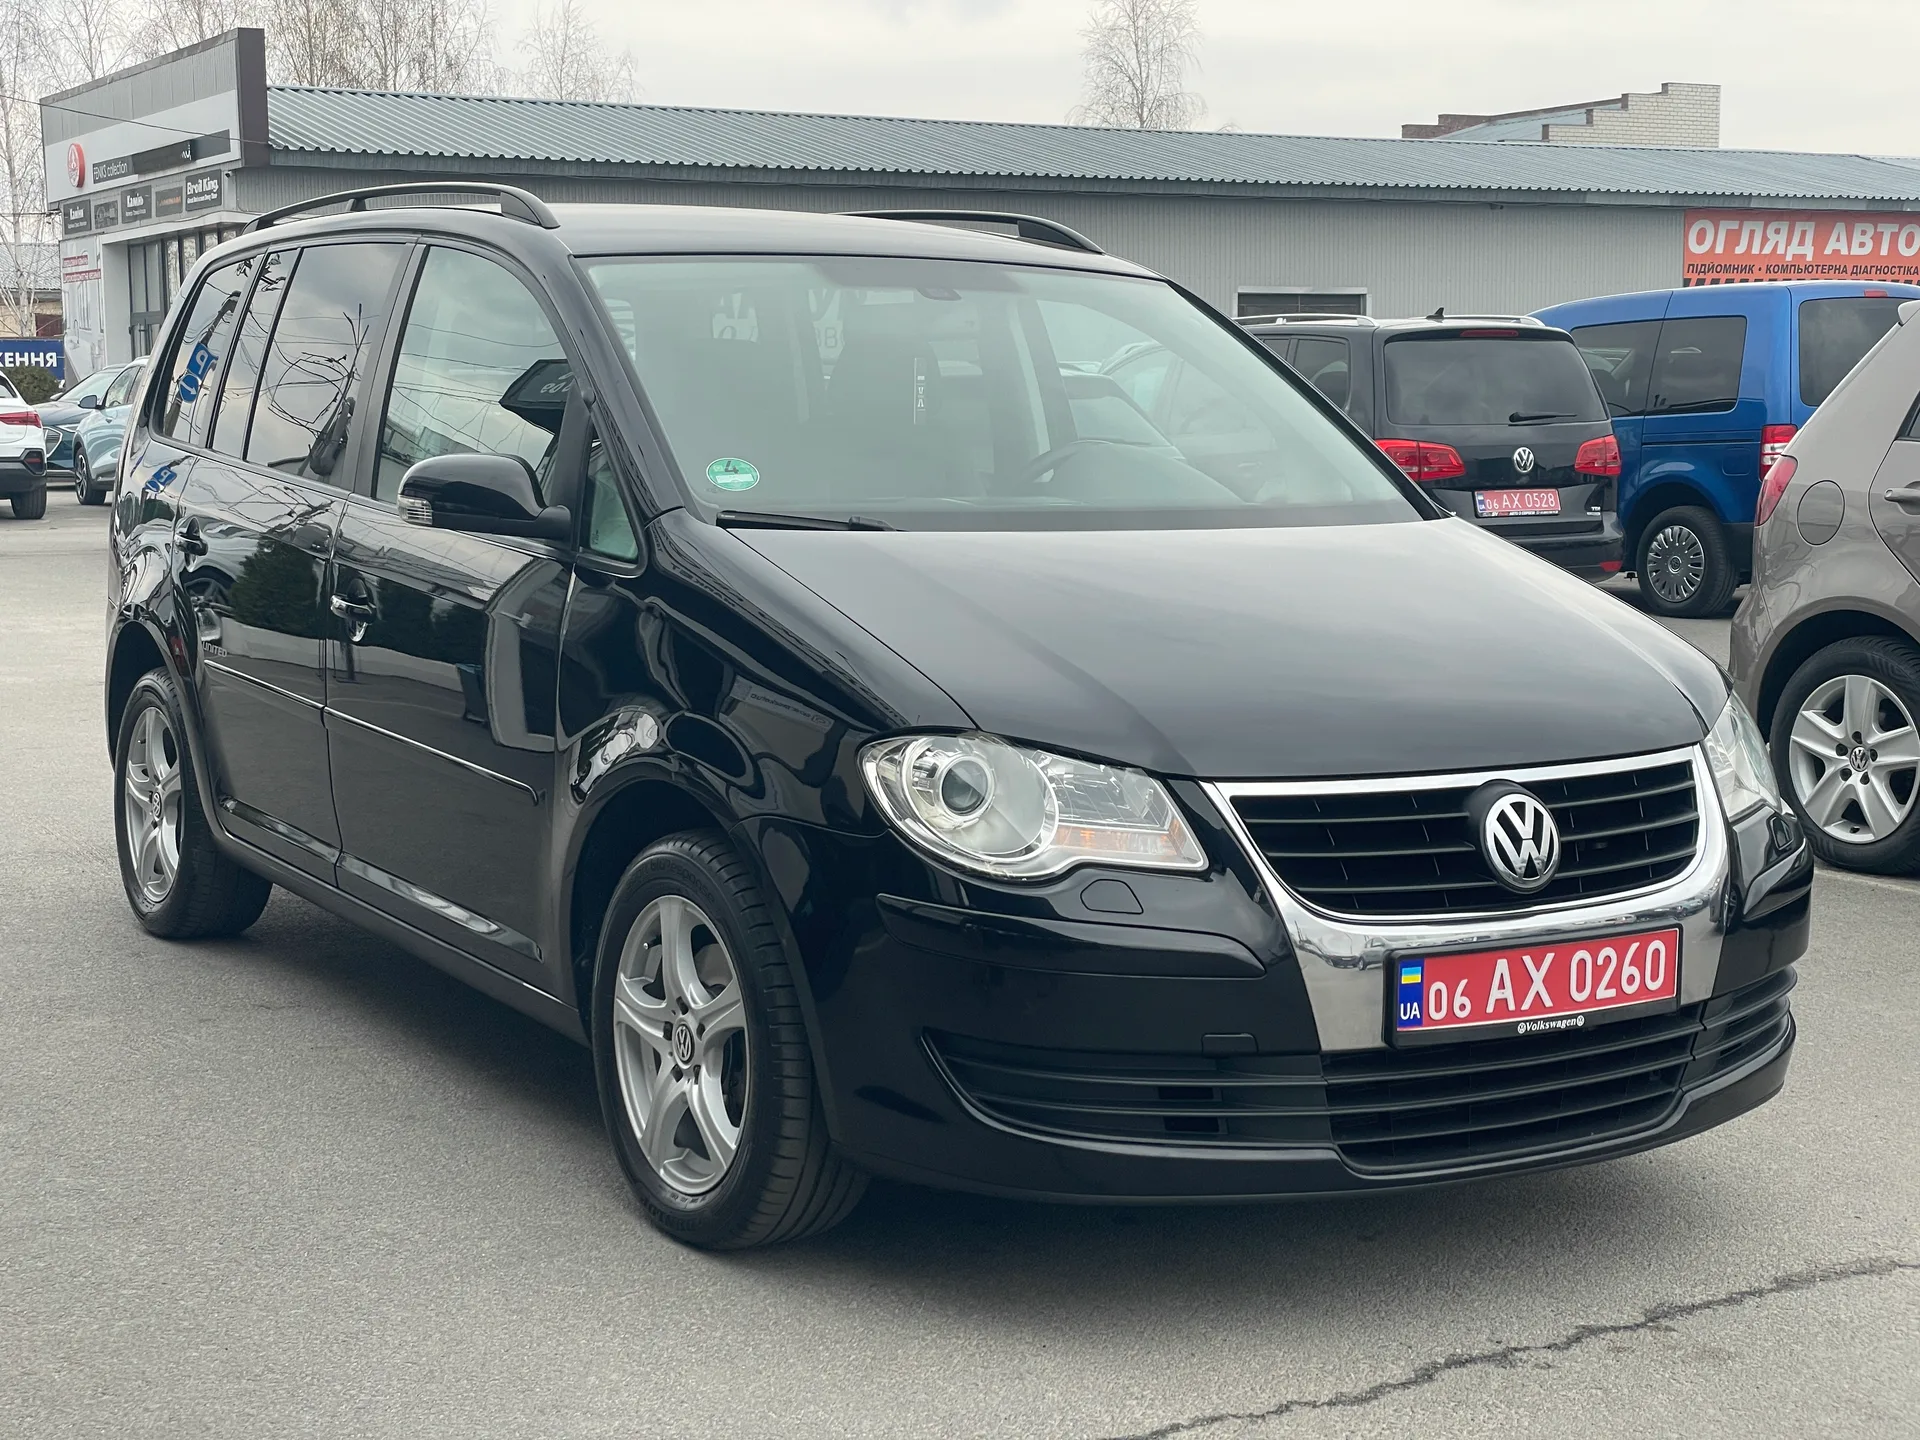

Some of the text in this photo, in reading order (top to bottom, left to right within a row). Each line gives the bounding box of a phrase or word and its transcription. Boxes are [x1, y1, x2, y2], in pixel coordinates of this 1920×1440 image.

[187, 177, 219, 195] Broil King
[1688, 219, 1920, 261] ОГЛЯД АВТО
[1687, 261, 1755, 275] ПІДЙОМНИК
[0, 351, 57, 367] ЕННЯ
[724, 460, 739, 474] 4
[1486, 492, 1555, 510] 06 AX 0528
[202, 641, 227, 658] UNITED
[1428, 939, 1666, 1021] 06 AX 0260
[1399, 1001, 1421, 1020] UA
[1526, 1016, 1577, 1032] Volkswagen
